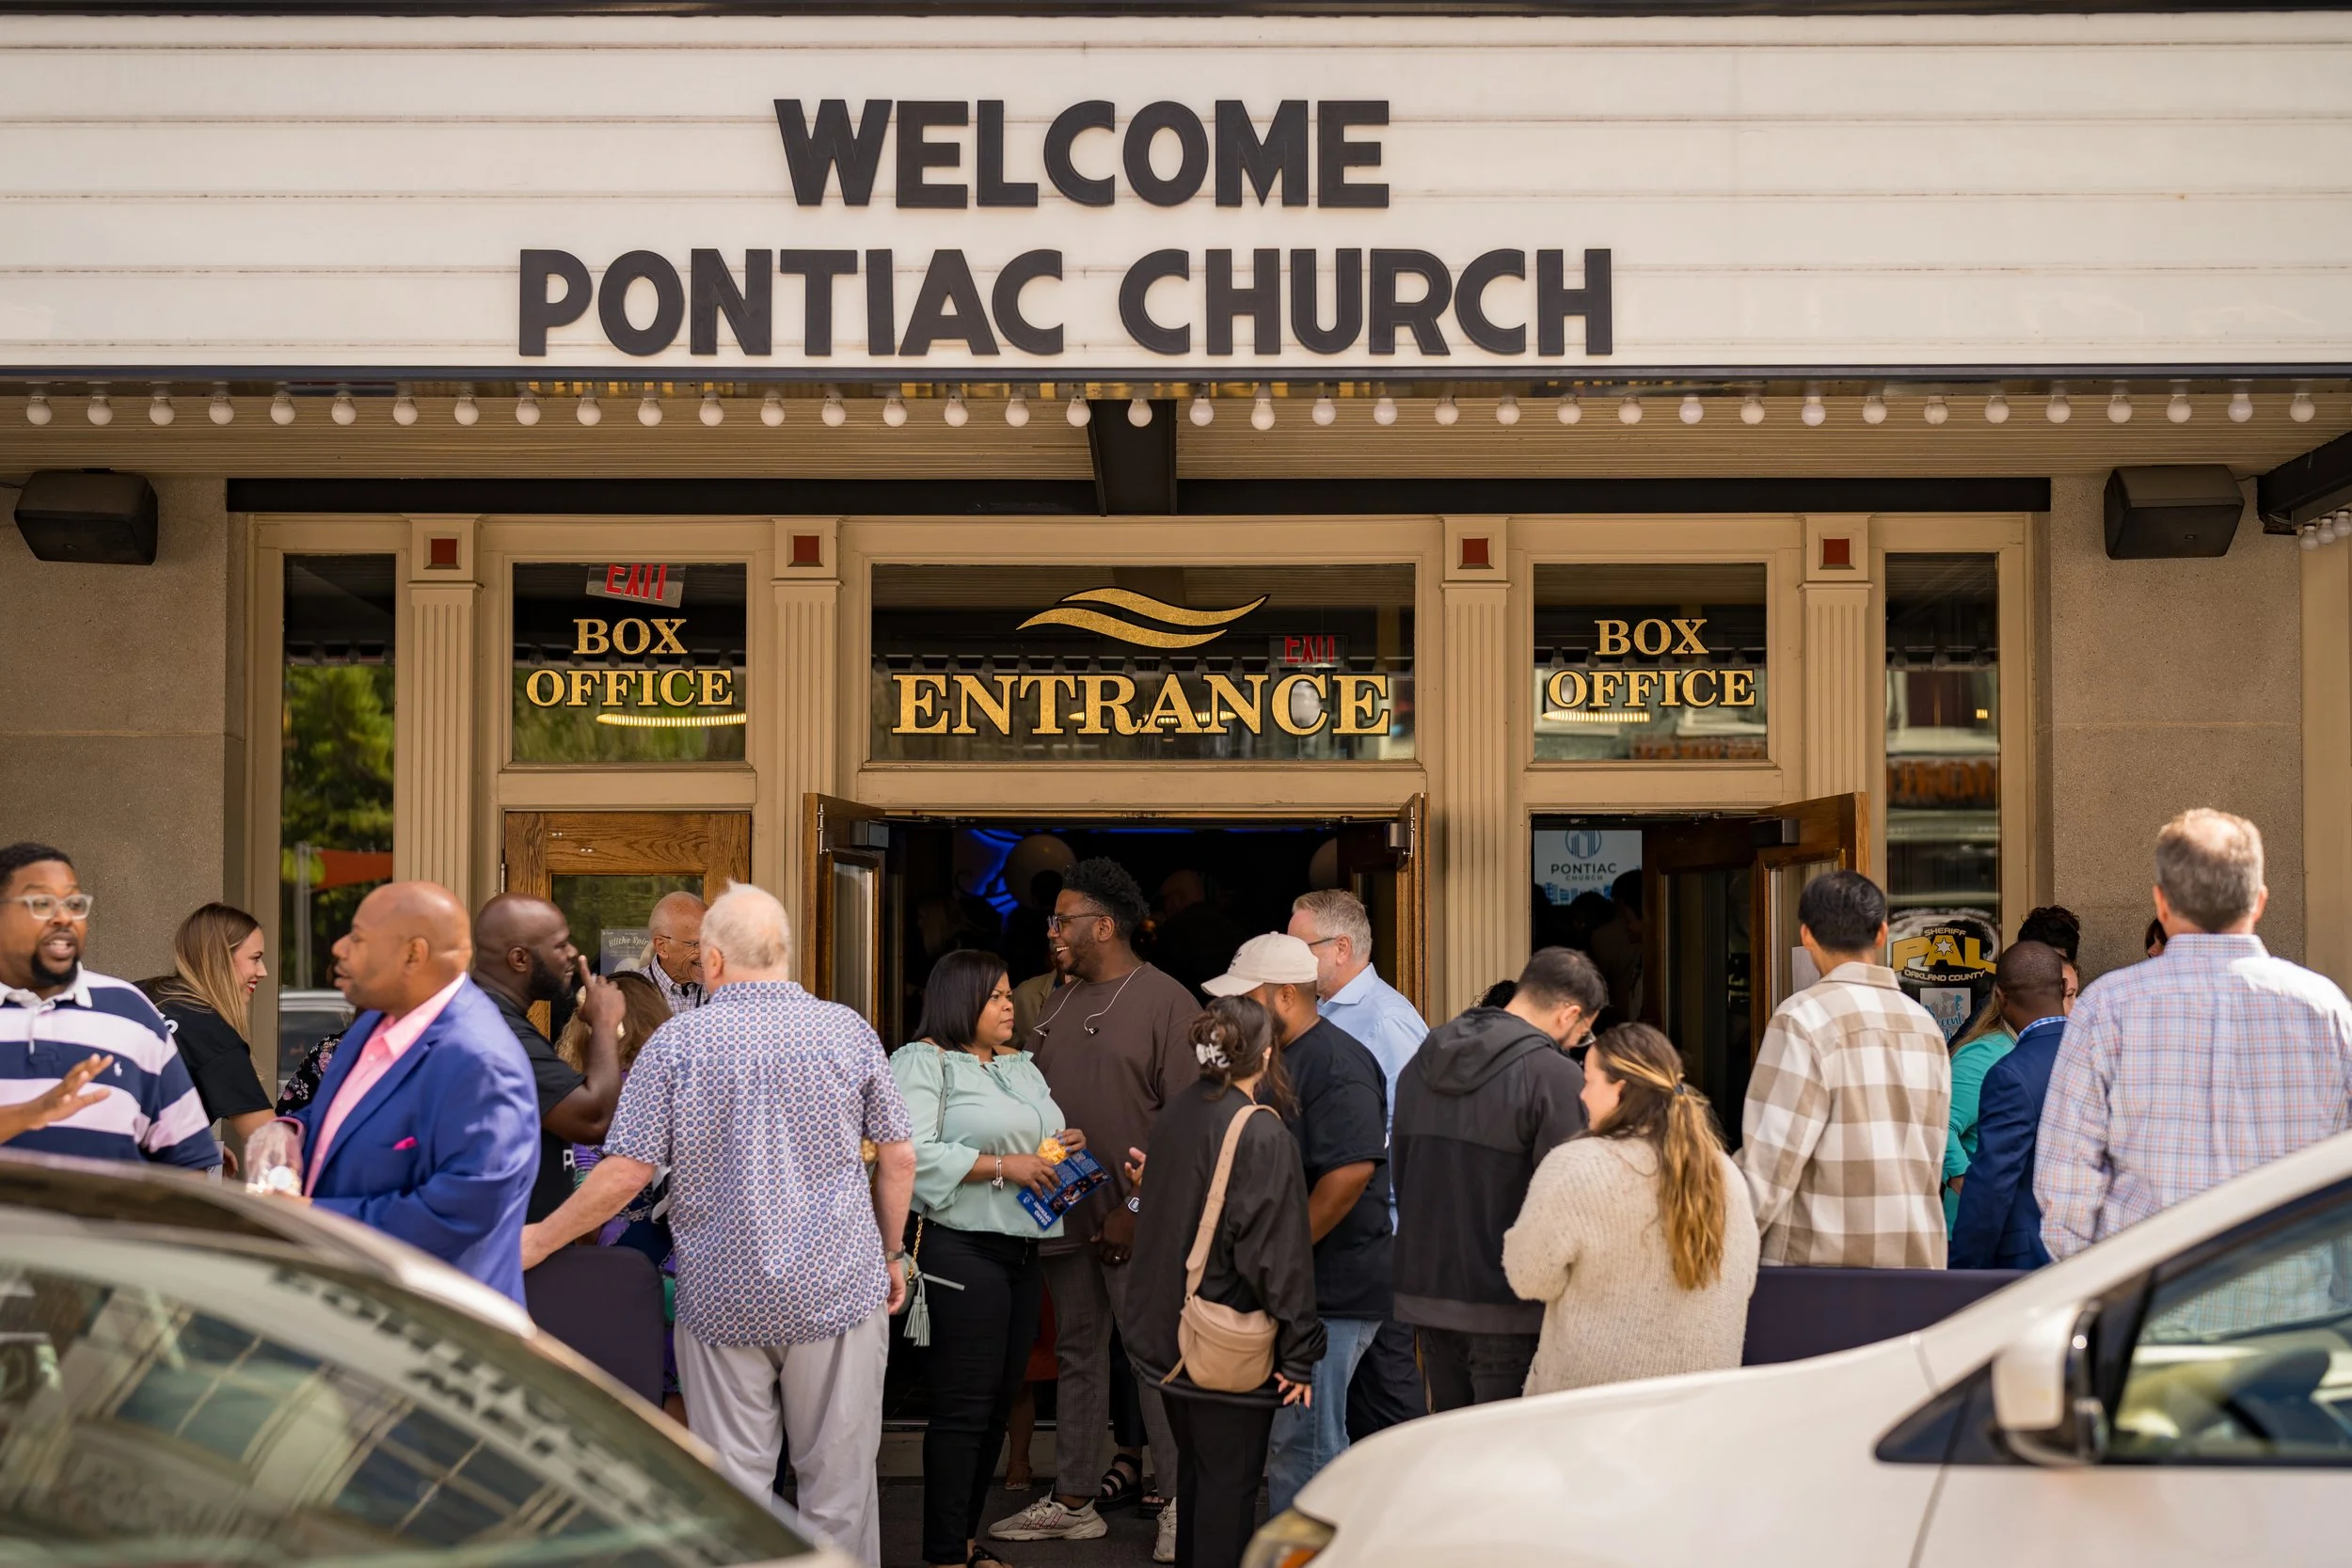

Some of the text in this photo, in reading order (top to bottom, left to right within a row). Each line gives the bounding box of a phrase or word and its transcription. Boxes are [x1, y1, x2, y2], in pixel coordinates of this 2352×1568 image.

[773, 99, 1390, 208] WELCOME
[519, 247, 1613, 356] PONTIAC CHURCH
[573, 617, 688, 655] BOX
[1594, 618, 1709, 656] BOX
[525, 669, 734, 706] OFFICE
[891, 673, 1391, 736] ENTRANCE
[1548, 669, 1756, 708] OFFICE
[1550, 863, 1617, 875] PONTIAC
[1924, 927, 1967, 937] SHERIFF
[1891, 934, 1997, 975] PAL
[1904, 969, 1986, 982] OAKLAND COUNTY
